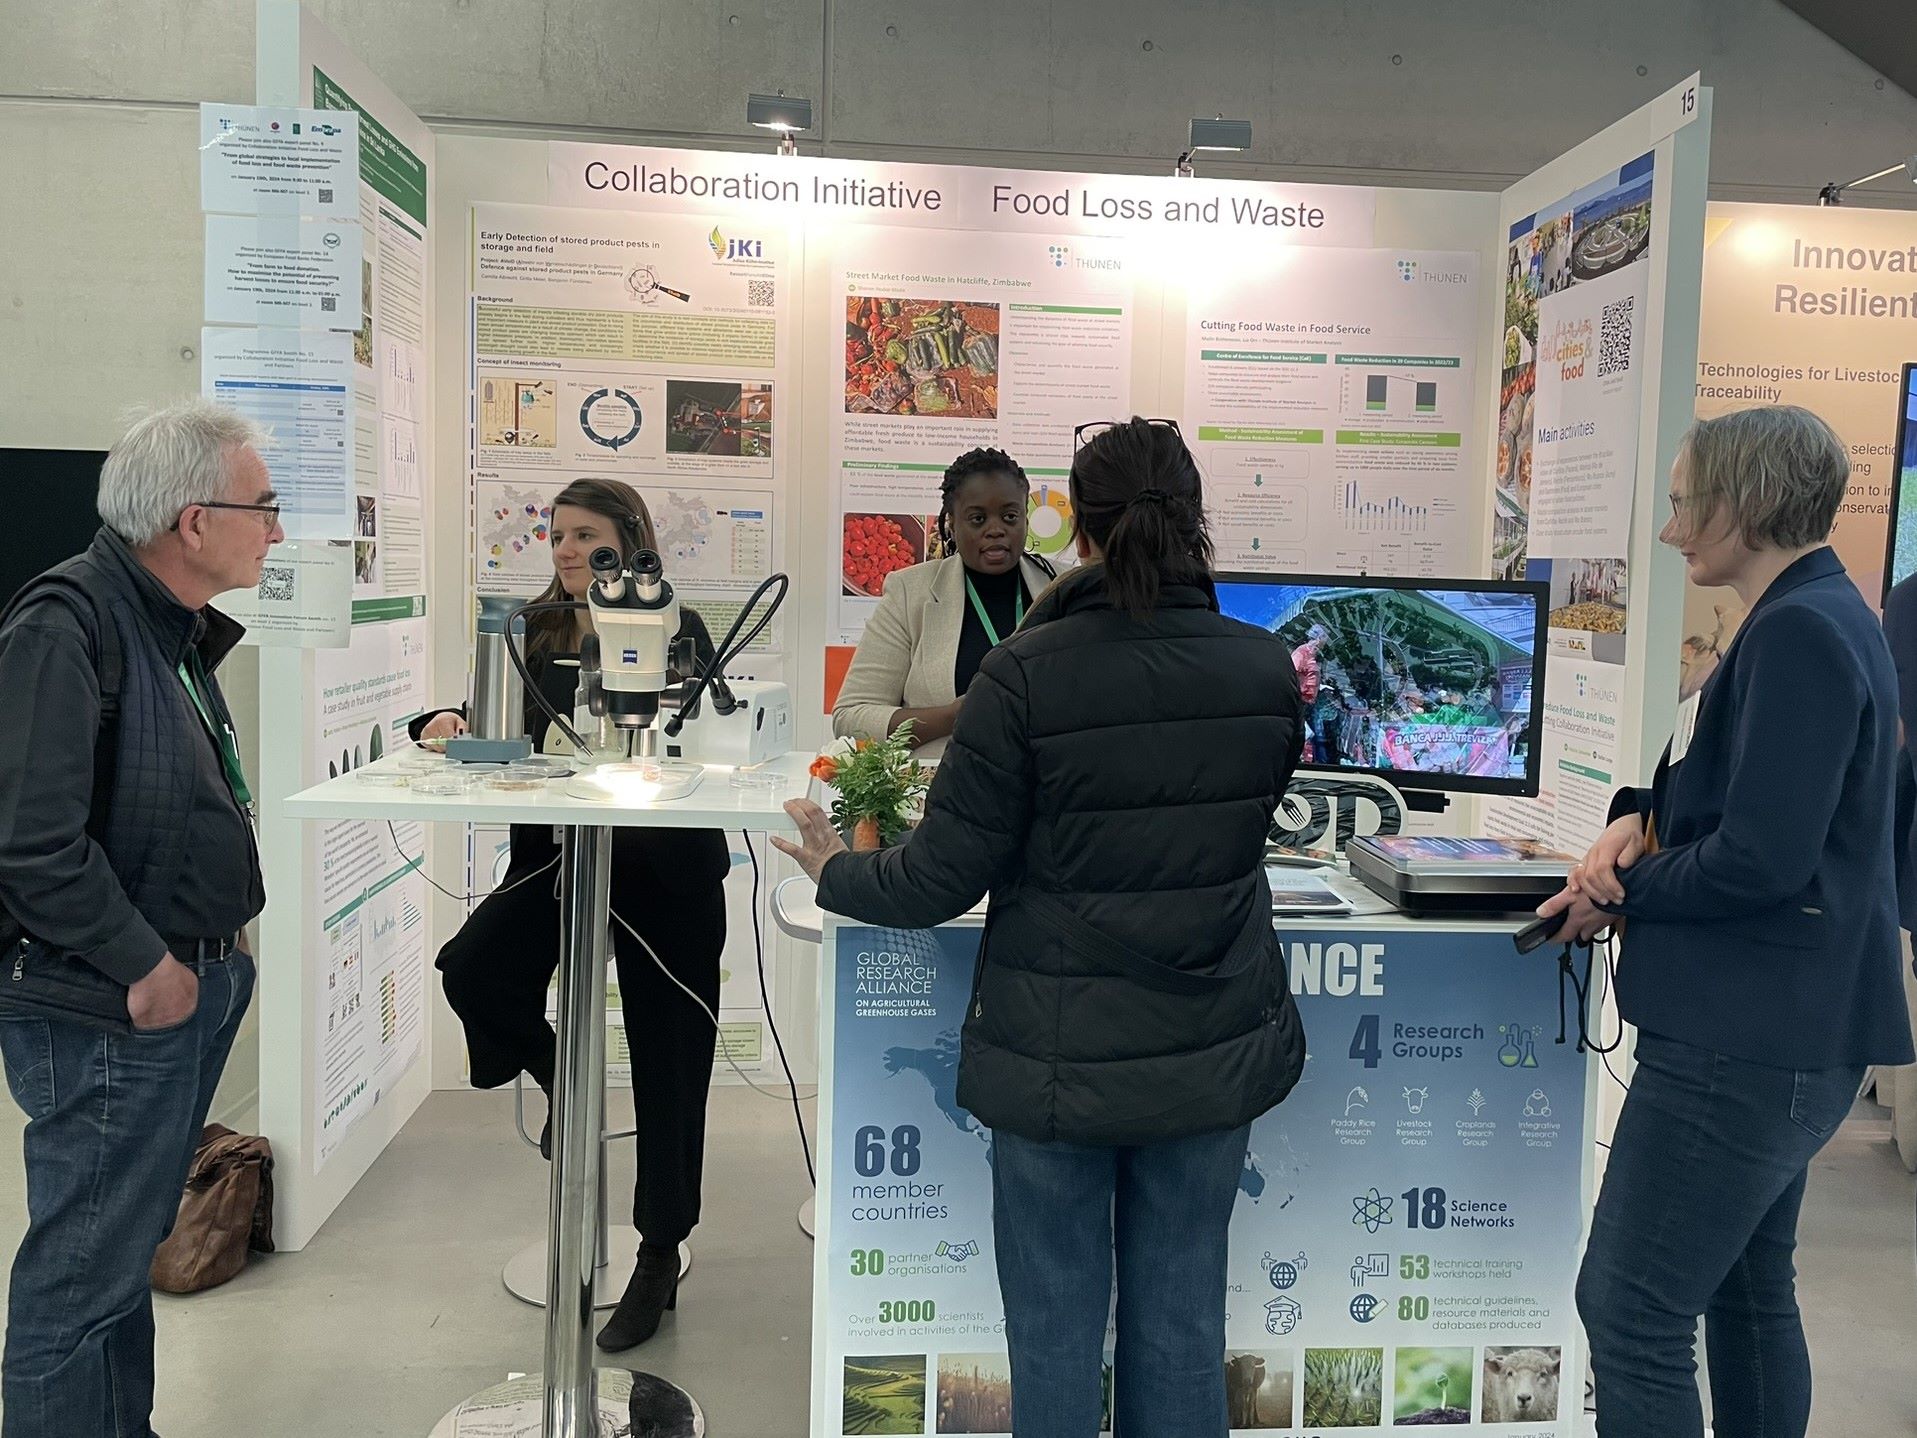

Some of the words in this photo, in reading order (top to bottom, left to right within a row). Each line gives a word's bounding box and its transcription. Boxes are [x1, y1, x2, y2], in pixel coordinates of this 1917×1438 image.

[1681, 87, 1695, 115] 15
[584, 162, 800, 202] Collaboration
[813, 176, 942, 210] Initiative
[993, 185, 1070, 216] Food
[1082, 190, 1153, 221] Loss
[1164, 197, 1219, 223] and
[1231, 198, 1325, 228] Waste
[480, 231, 503, 241] Early
[505, 232, 547, 243] Detection
[549, 235, 559, 243] of
[560, 237, 588, 245] stored
[590, 238, 624, 248] product
[626, 240, 650, 249] pests
[652, 241, 660, 249] in
[480, 243, 514, 253] storage
[516, 244, 533, 253] and
[535, 245, 554, 254] field
[846, 272, 869, 280] Street
[872, 273, 899, 281] Market
[901, 274, 920, 282] Food
[922, 275, 946, 283] Waste
[957, 277, 991, 286] Hatcliffe,
[993, 278, 1032, 287] Zimbabwe
[1200, 320, 1236, 332] Cutting
[1239, 322, 1262, 331] Food
[1265, 322, 1295, 333] Waste
[1298, 323, 1307, 332] in
[1310, 324, 1333, 333] Food
[1336, 325, 1371, 334] Service
[1556, 341, 1584, 362] cities
[1561, 357, 1585, 381] food
[1699, 362, 1803, 383] Technologies
[1808, 366, 1830, 381] for
[1695, 383, 1781, 403] Traceability
[1538, 427, 1558, 444] Main
[1560, 421, 1595, 442] activities
[1868, 485, 1880, 496] to
[856, 952, 920, 966] GLOBAL
[856, 967, 937, 981] RESEARCH
[1280, 942, 1385, 997] NCE
[855, 981, 932, 994] ALLIANCE
[855, 1000, 869, 1008] ON
[871, 999, 930, 1007] AGRICULTURAL
[855, 1009, 909, 1017] GREENHOUSE
[910, 1008, 937, 1016] GASES
[1393, 1023, 1484, 1040] Research
[1349, 1014, 1382, 1069] 4
[1392, 1042, 1464, 1061] Groups
[1331, 1119, 1357, 1129] Paddy
[1359, 1119, 1376, 1128] Rice
[1396, 1119, 1432, 1128] Livestock
[1455, 1120, 1496, 1130] Croplands
[1518, 1121, 1561, 1131] Integrative
[1335, 1128, 1372, 1137] Research
[1396, 1128, 1432, 1137] Research
[1457, 1129, 1494, 1138] Research
[1521, 1130, 1558, 1139] Research
[1340, 1137, 1366, 1146] Group
[1401, 1137, 1427, 1146] Group
[1462, 1138, 1488, 1147] Group
[1526, 1139, 1552, 1148] Group
[854, 1124, 921, 1178] 68
[852, 1181, 944, 1199] member
[851, 1202, 948, 1221] countries
[1401, 1186, 1446, 1230] 18
[1451, 1200, 1507, 1212] Science
[1451, 1216, 1515, 1228] Networks
[850, 1249, 885, 1276] 30
[888, 1252, 933, 1265] partner
[1433, 1259, 1482, 1269] technical
[1485, 1258, 1523, 1271] training
[888, 1263, 967, 1278] organisations
[1399, 1254, 1430, 1280] 53
[1433, 1269, 1486, 1281] workshops
[1488, 1269, 1512, 1279] held
[1397, 1295, 1429, 1321] 80
[1433, 1296, 1482, 1305] technical
[1484, 1296, 1538, 1307] guidelines,
[848, 1315, 875, 1325] Over
[879, 1300, 935, 1323] 3000
[938, 1311, 984, 1321] scientists
[1432, 1309, 1477, 1318] resource
[1479, 1308, 1526, 1318] materials
[1528, 1308, 1550, 1318] and
[848, 1325, 894, 1337] involved
[897, 1325, 906, 1336] in
[909, 1323, 956, 1335] activities
[959, 1323, 970, 1334] of
[972, 1323, 990, 1334] the
[1432, 1320, 1487, 1330] databases
[1489, 1320, 1541, 1332] produced
